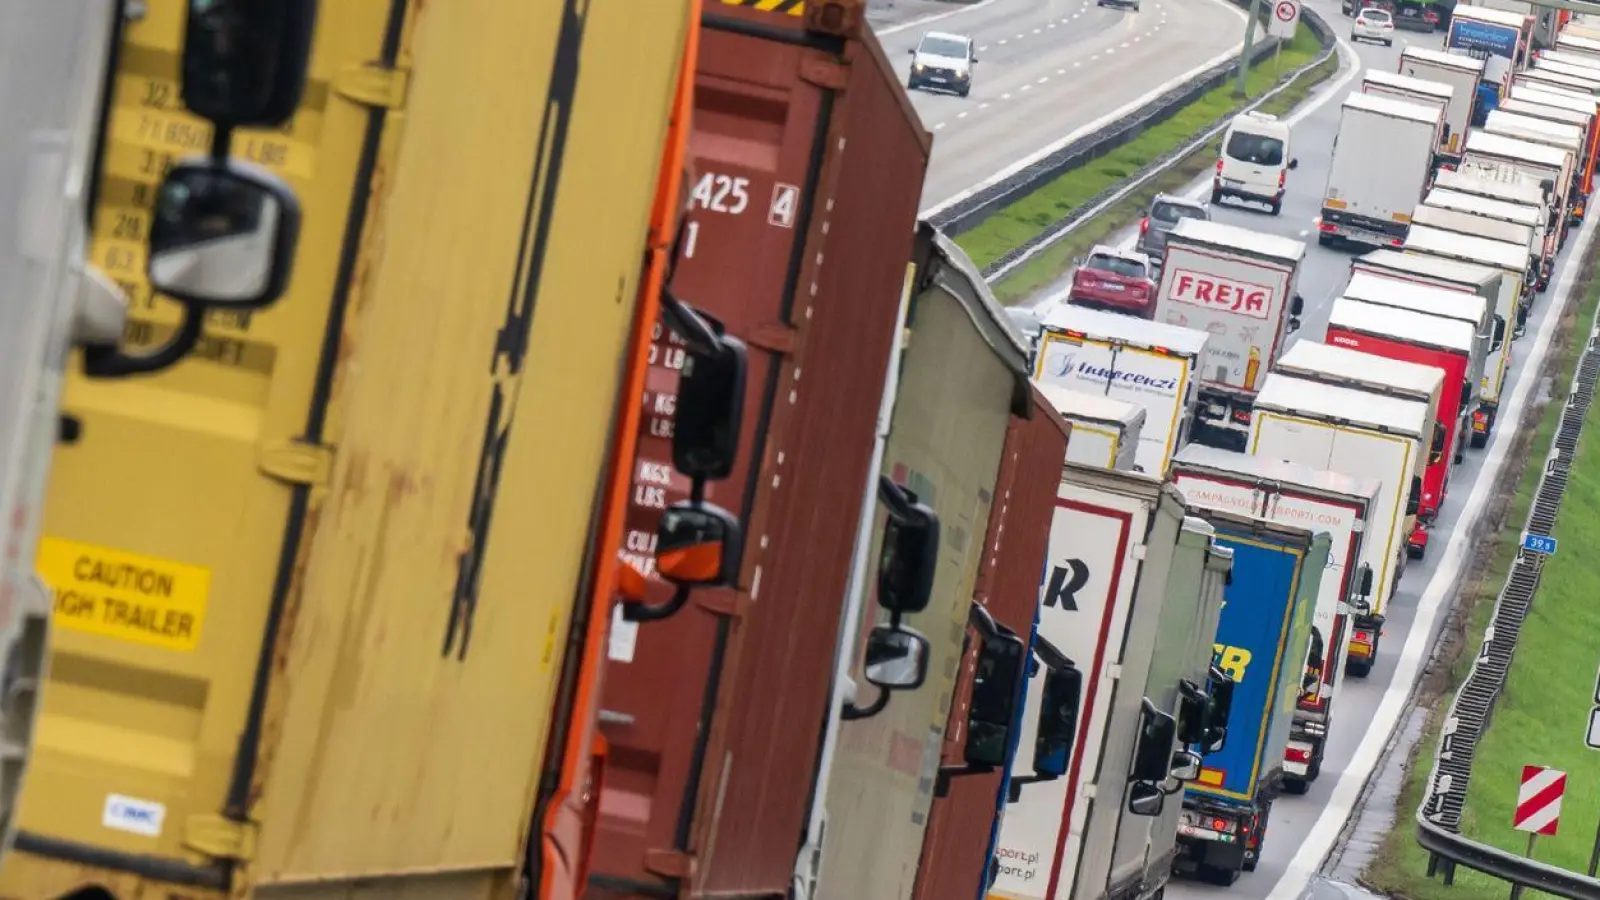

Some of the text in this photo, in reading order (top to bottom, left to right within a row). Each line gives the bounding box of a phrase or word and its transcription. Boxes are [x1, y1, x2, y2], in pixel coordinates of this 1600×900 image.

[772, 187, 796, 226] 4
[1176, 275, 1265, 312] FREJA
[73, 555, 175, 598] CAUTION
[1043, 558, 1090, 612] R
[102, 597, 195, 641] TRAILER
